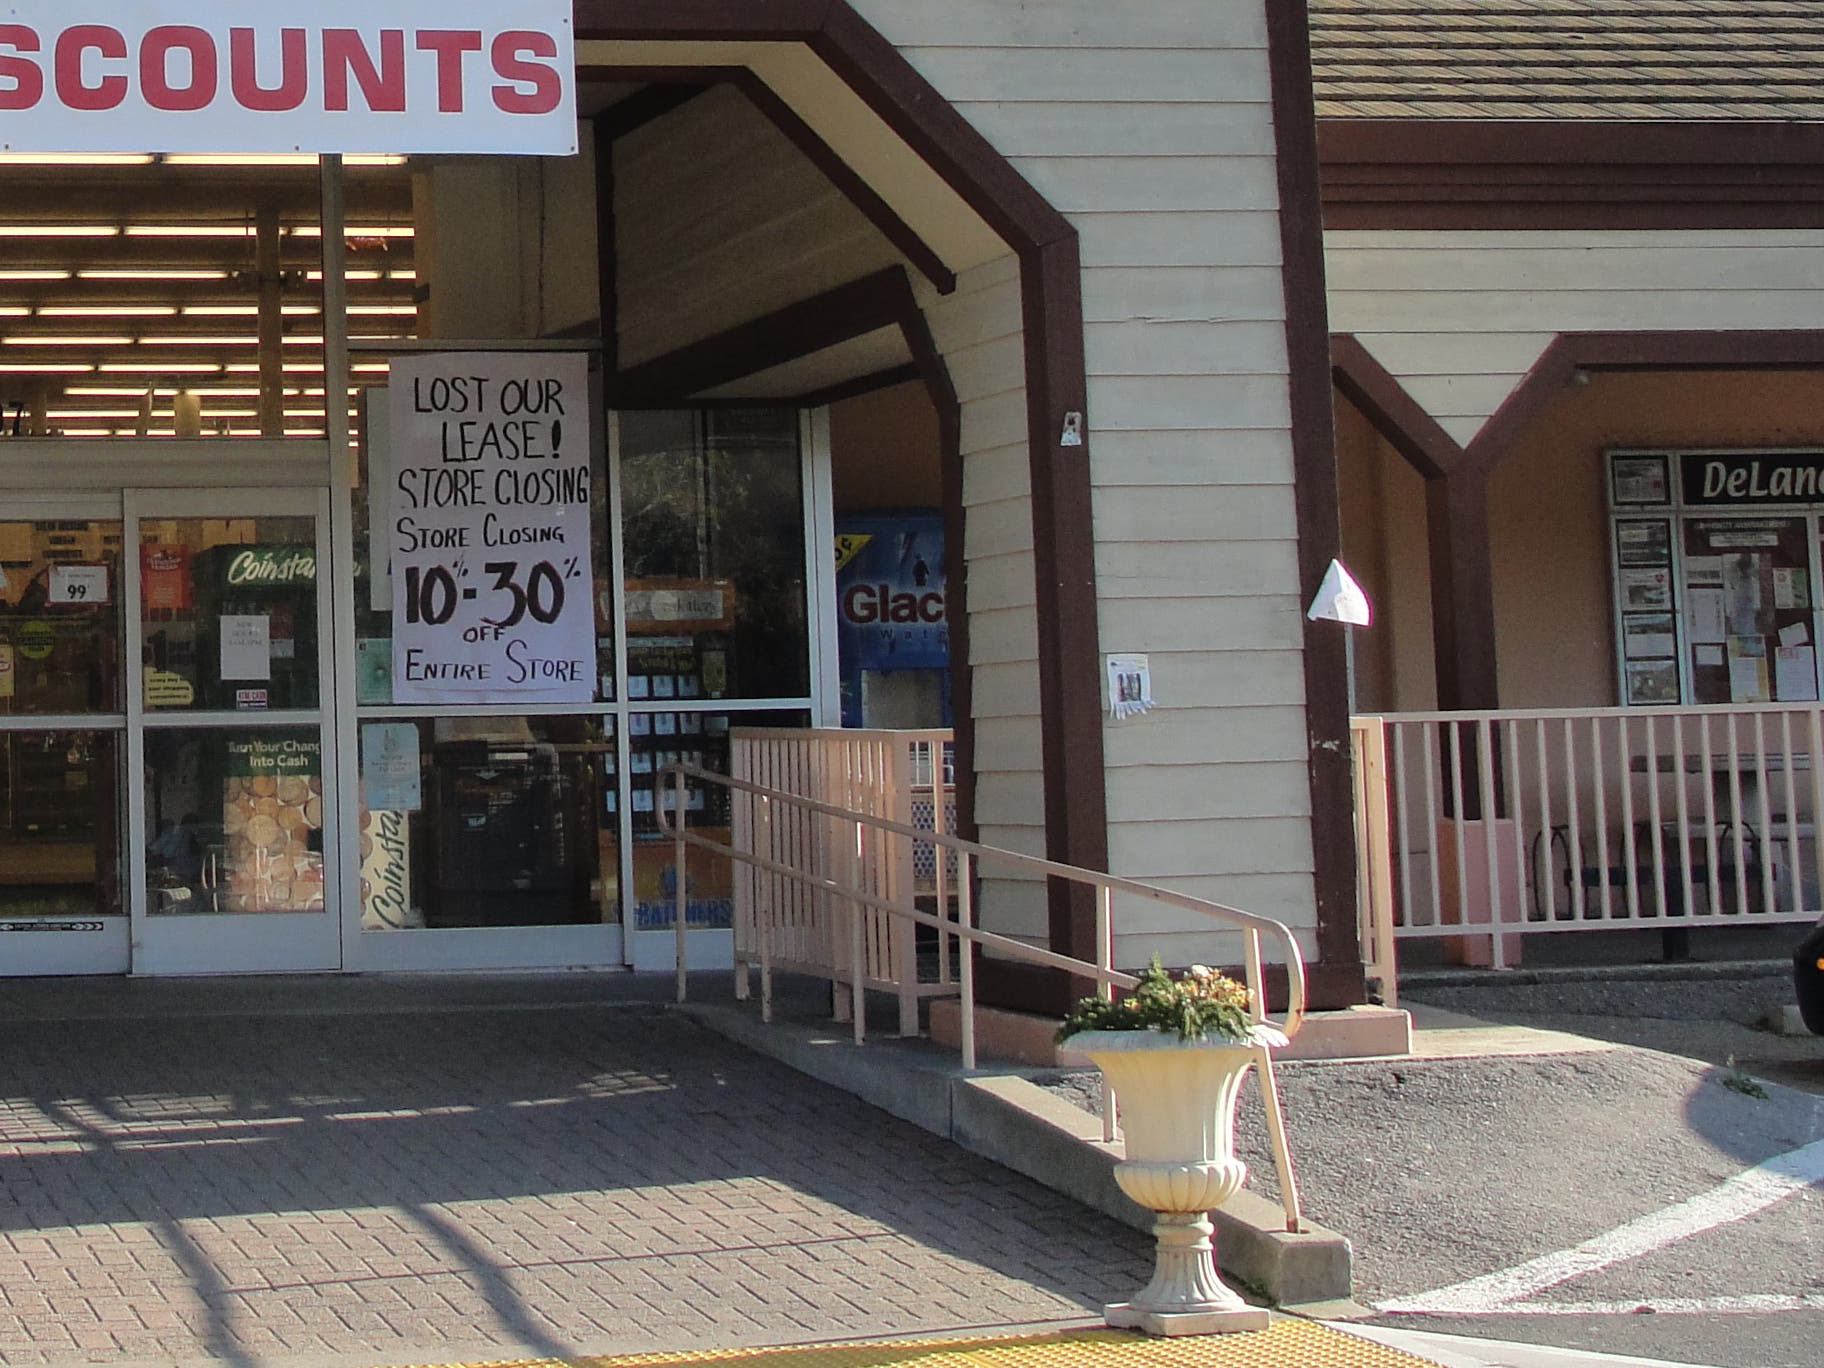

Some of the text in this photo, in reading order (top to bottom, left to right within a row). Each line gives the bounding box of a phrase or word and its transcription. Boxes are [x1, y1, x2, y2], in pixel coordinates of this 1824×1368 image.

[414, 376, 565, 416] LOST OUR
[398, 465, 589, 509] STORE CLOSING
[1702, 460, 1824, 499] DeLan
[396, 513, 565, 552] STORE CLOSING
[227, 550, 316, 584] Coinsta
[843, 583, 945, 624] Glac
[462, 626, 506, 643] OFF
[405, 648, 492, 682] ENTIRE
[505, 639, 585, 684] STORE
[249, 753, 309, 767] Into Cash
[283, 739, 321, 754] Chang
[370, 810, 417, 929] Coinsta
